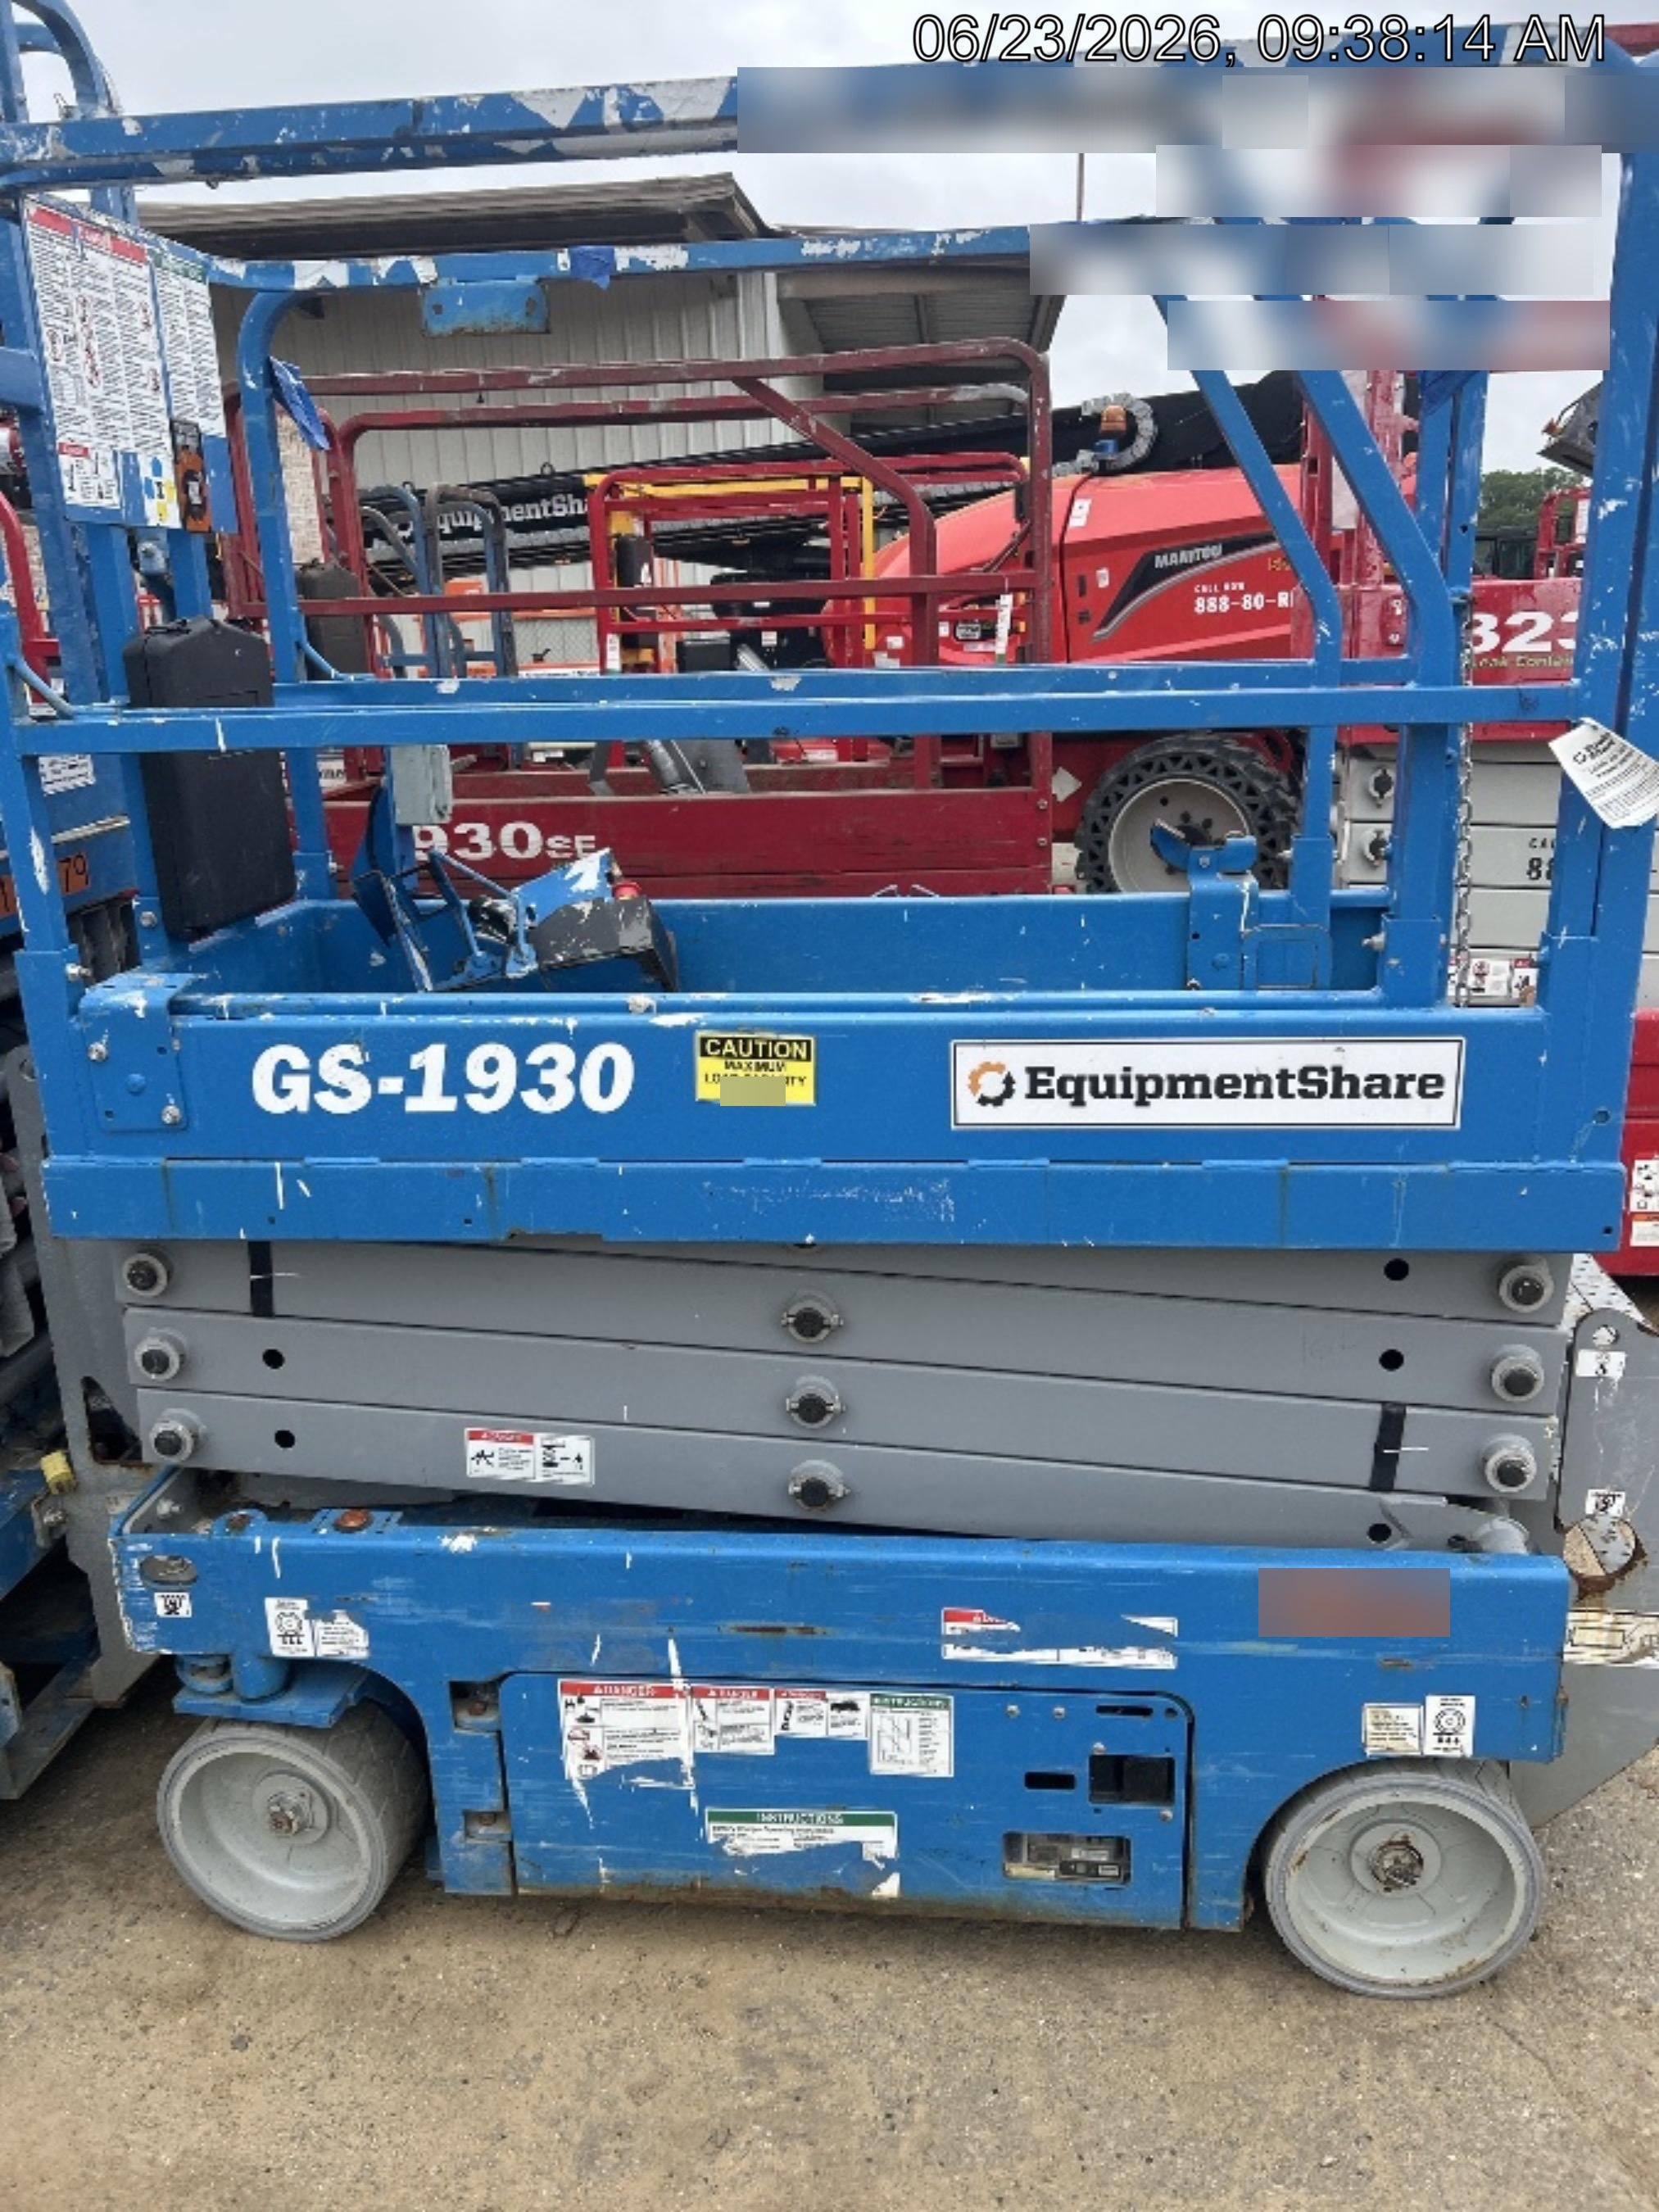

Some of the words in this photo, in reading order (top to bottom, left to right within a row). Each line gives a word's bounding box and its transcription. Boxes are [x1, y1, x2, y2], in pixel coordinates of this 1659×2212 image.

[1154, 542, 1223, 569] MANITOU
[705, 1038, 808, 1059] CAUTION
[252, 1042, 635, 1114] GS-1930
[1024, 1065, 1446, 1107] EquipmentShare
[603, 1684, 656, 1697] DANGER
